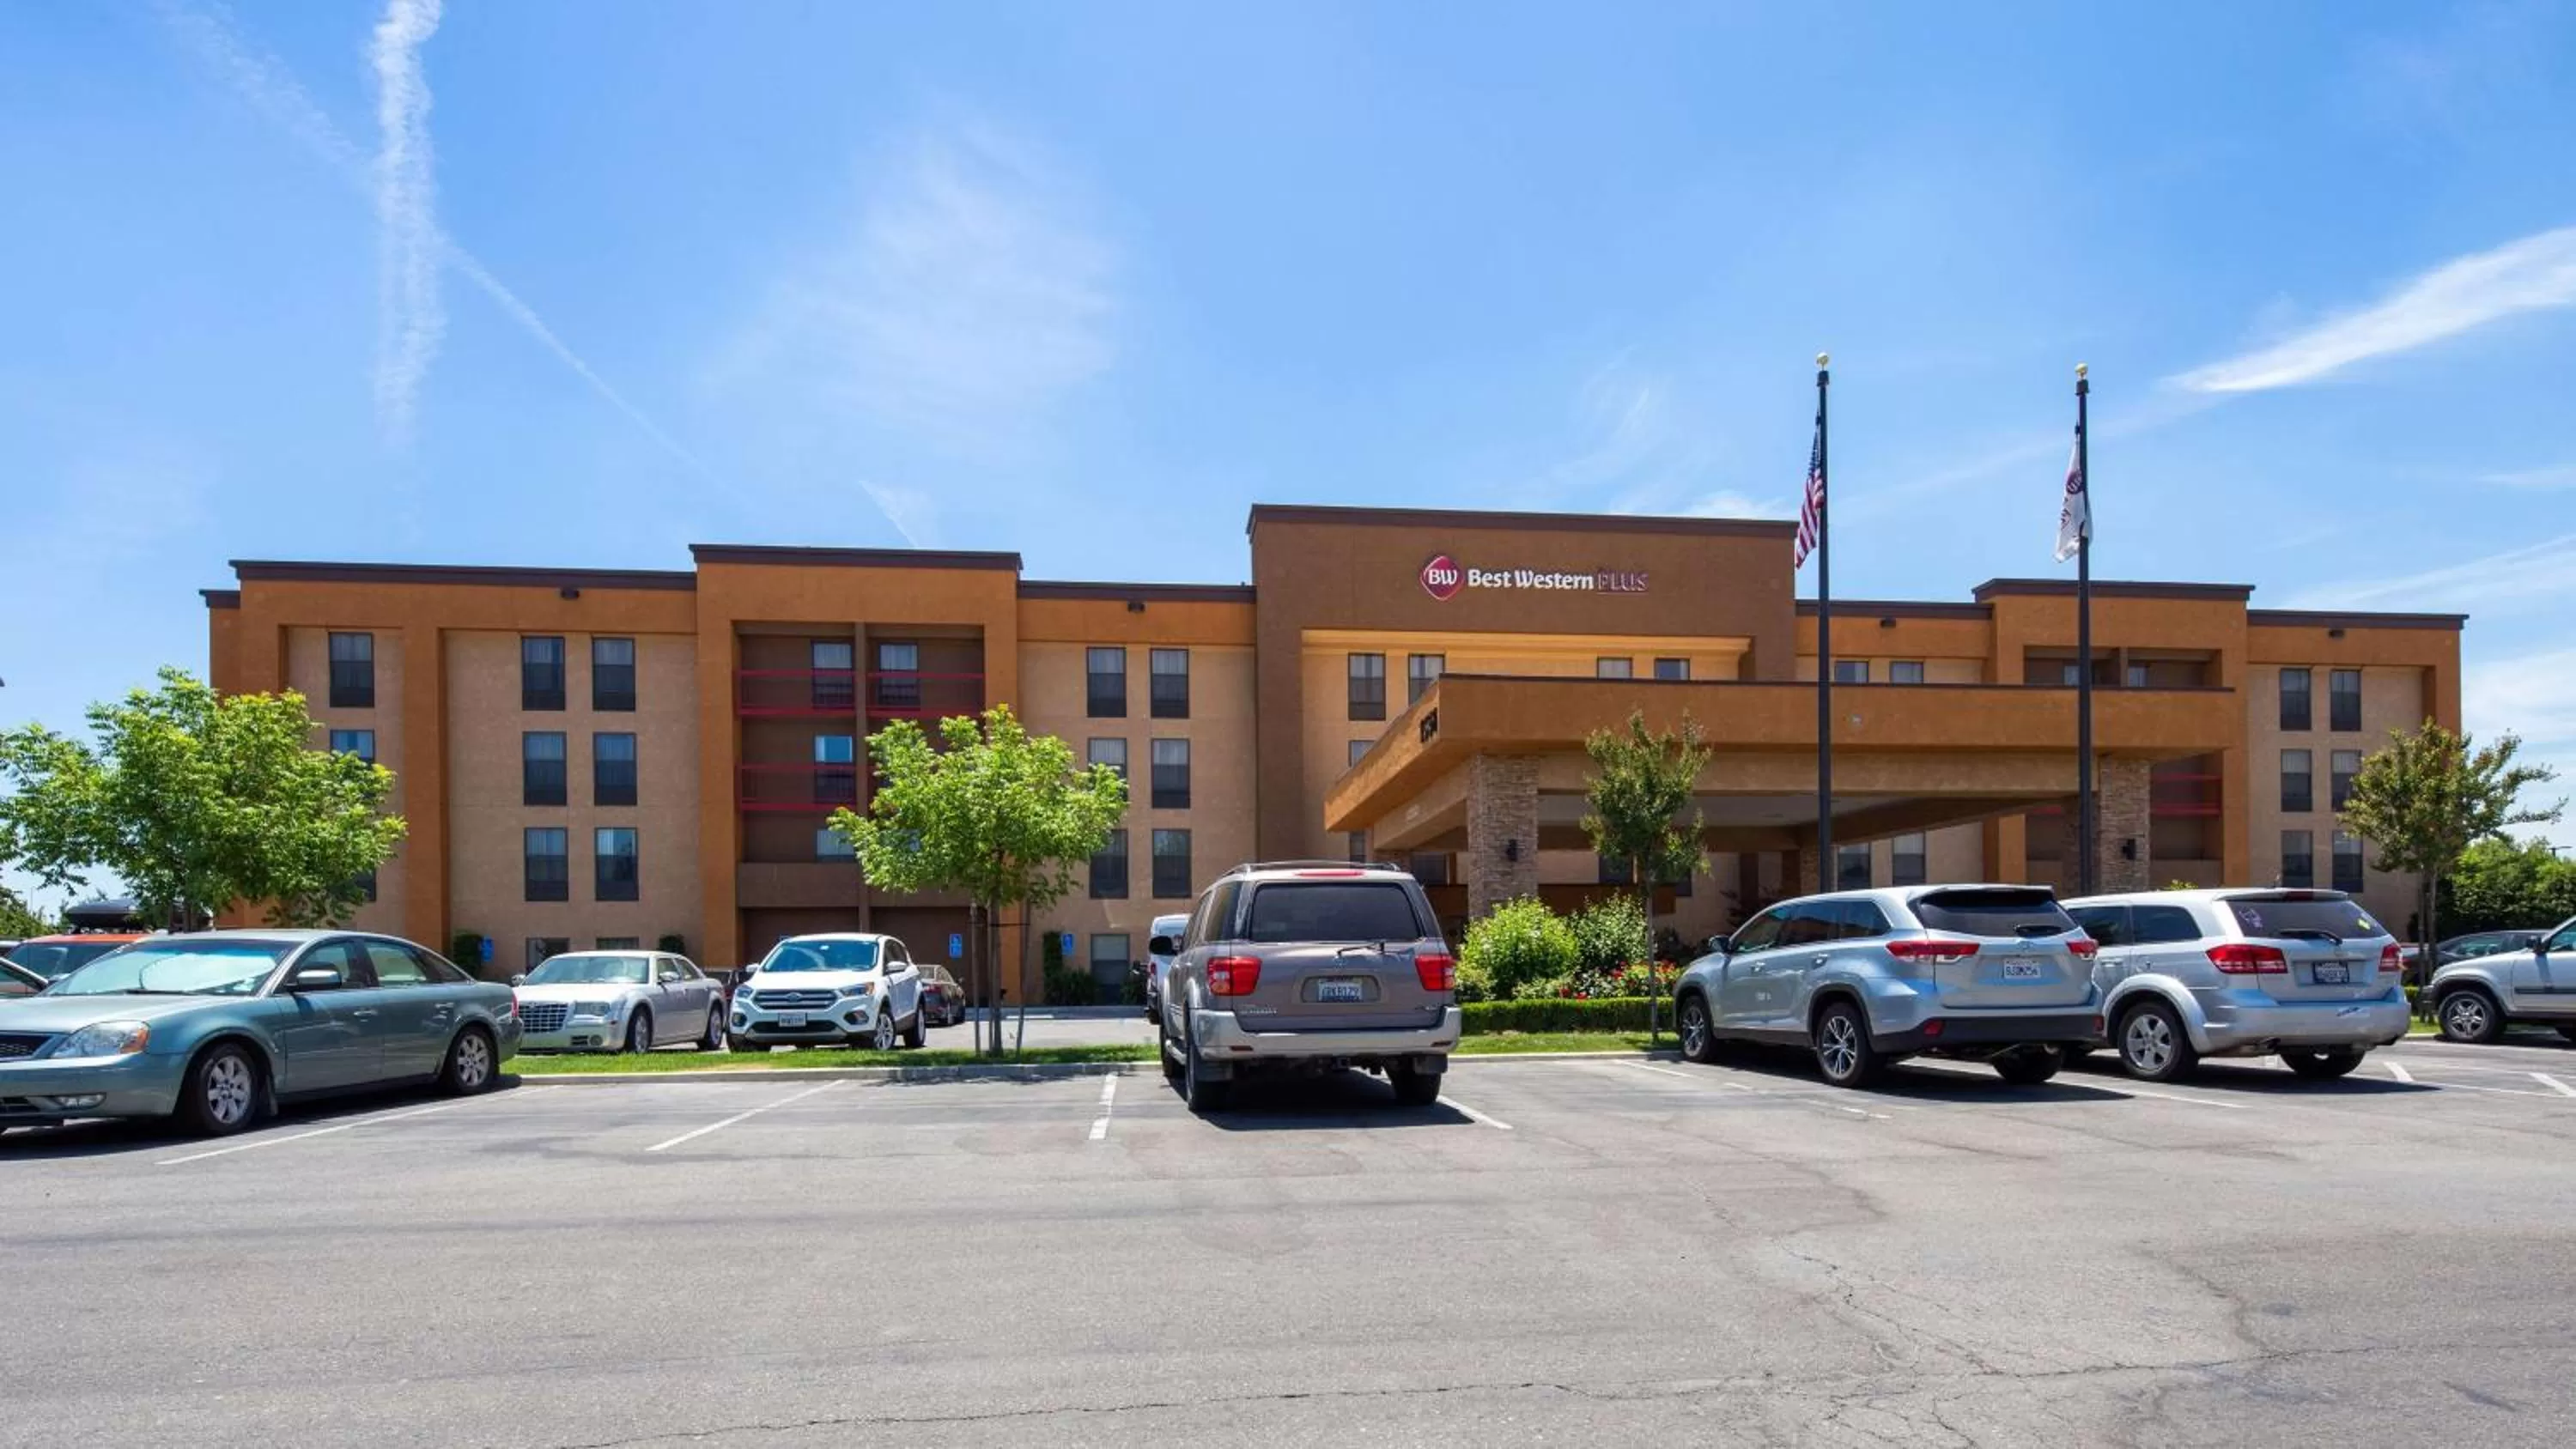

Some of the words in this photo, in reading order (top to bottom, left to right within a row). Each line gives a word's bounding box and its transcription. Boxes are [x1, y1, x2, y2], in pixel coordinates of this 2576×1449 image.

[1427, 568, 1458, 585] BW
[1467, 568, 1512, 588] Best
[1514, 570, 1595, 591] Western
[1596, 568, 1649, 591] PLUS
